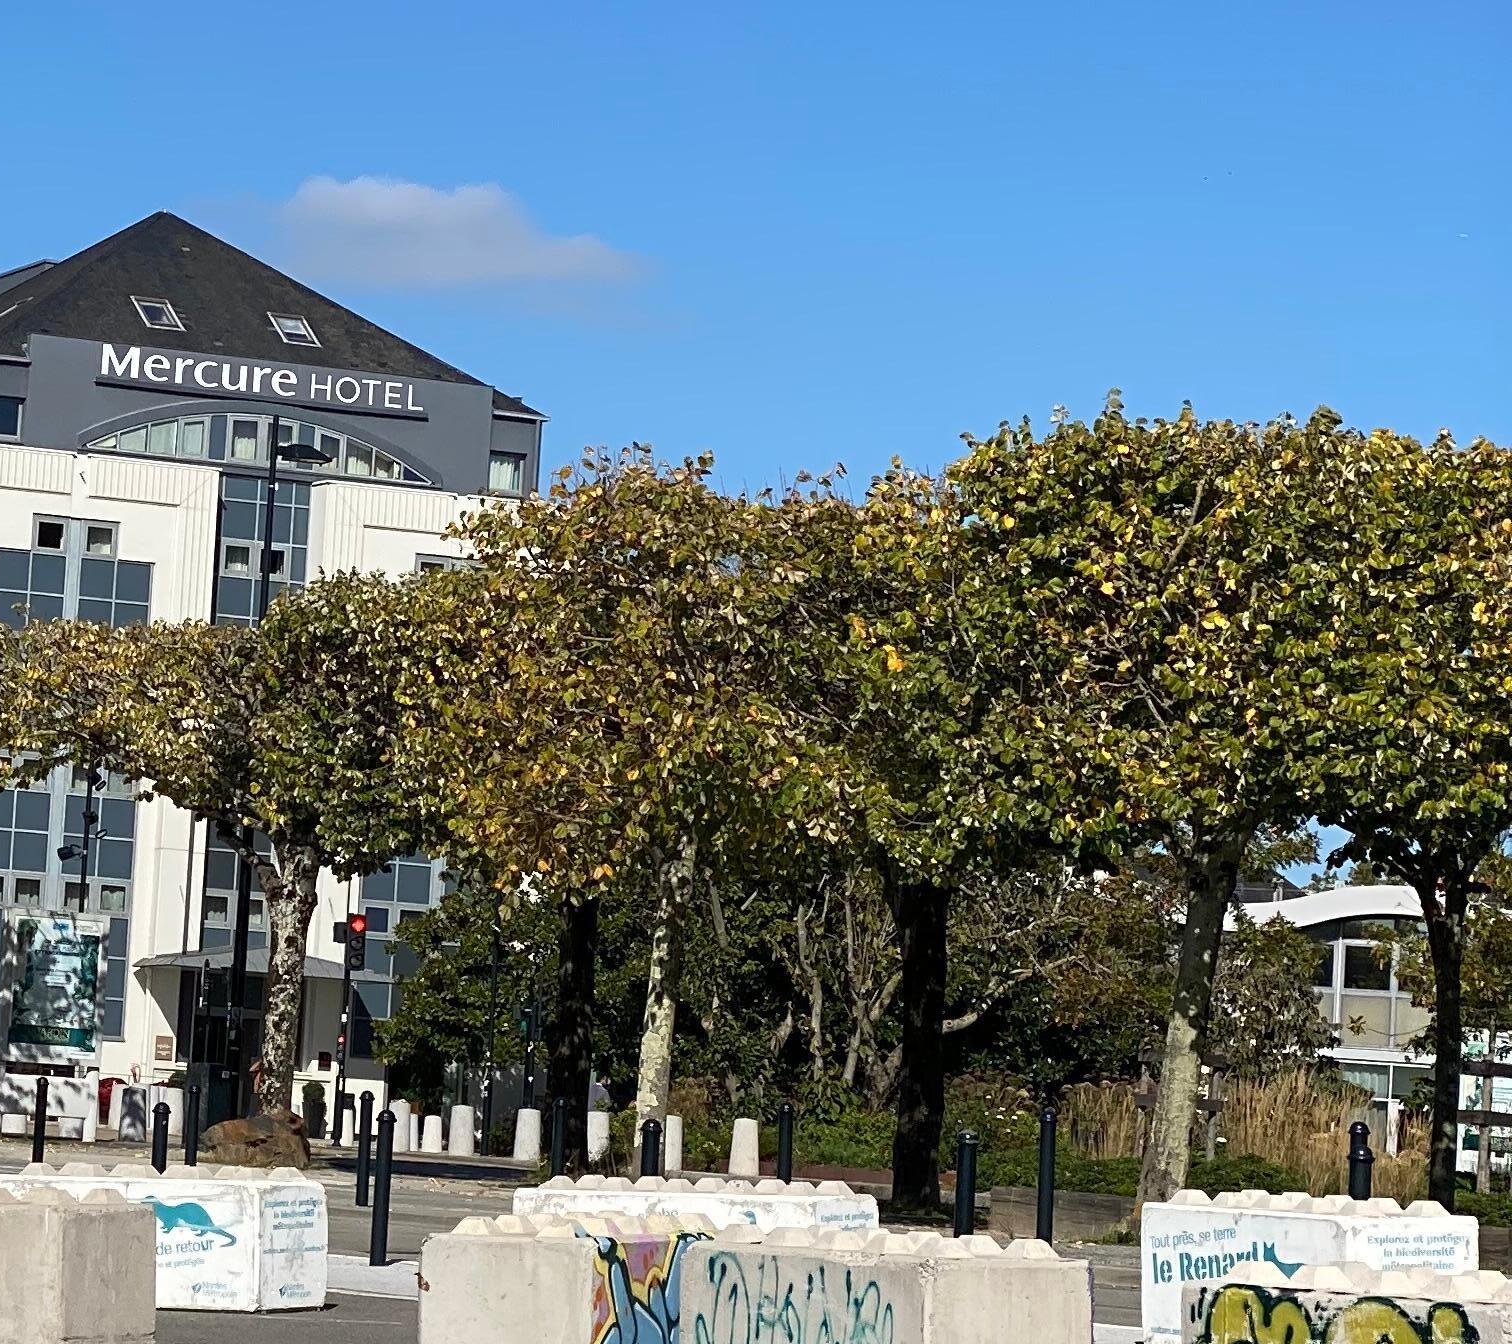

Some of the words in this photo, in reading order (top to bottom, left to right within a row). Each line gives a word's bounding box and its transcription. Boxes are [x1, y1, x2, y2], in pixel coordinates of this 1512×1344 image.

[100, 343, 298, 397] Mercure
[310, 375, 424, 411] HOTEL
[156, 1243, 172, 1255] de
[175, 1239, 214, 1254] retour
[1151, 1236, 1170, 1249] Tout
[1199, 1231, 1211, 1242] se
[1213, 1227, 1236, 1242] terre
[1152, 1253, 1173, 1284] le
